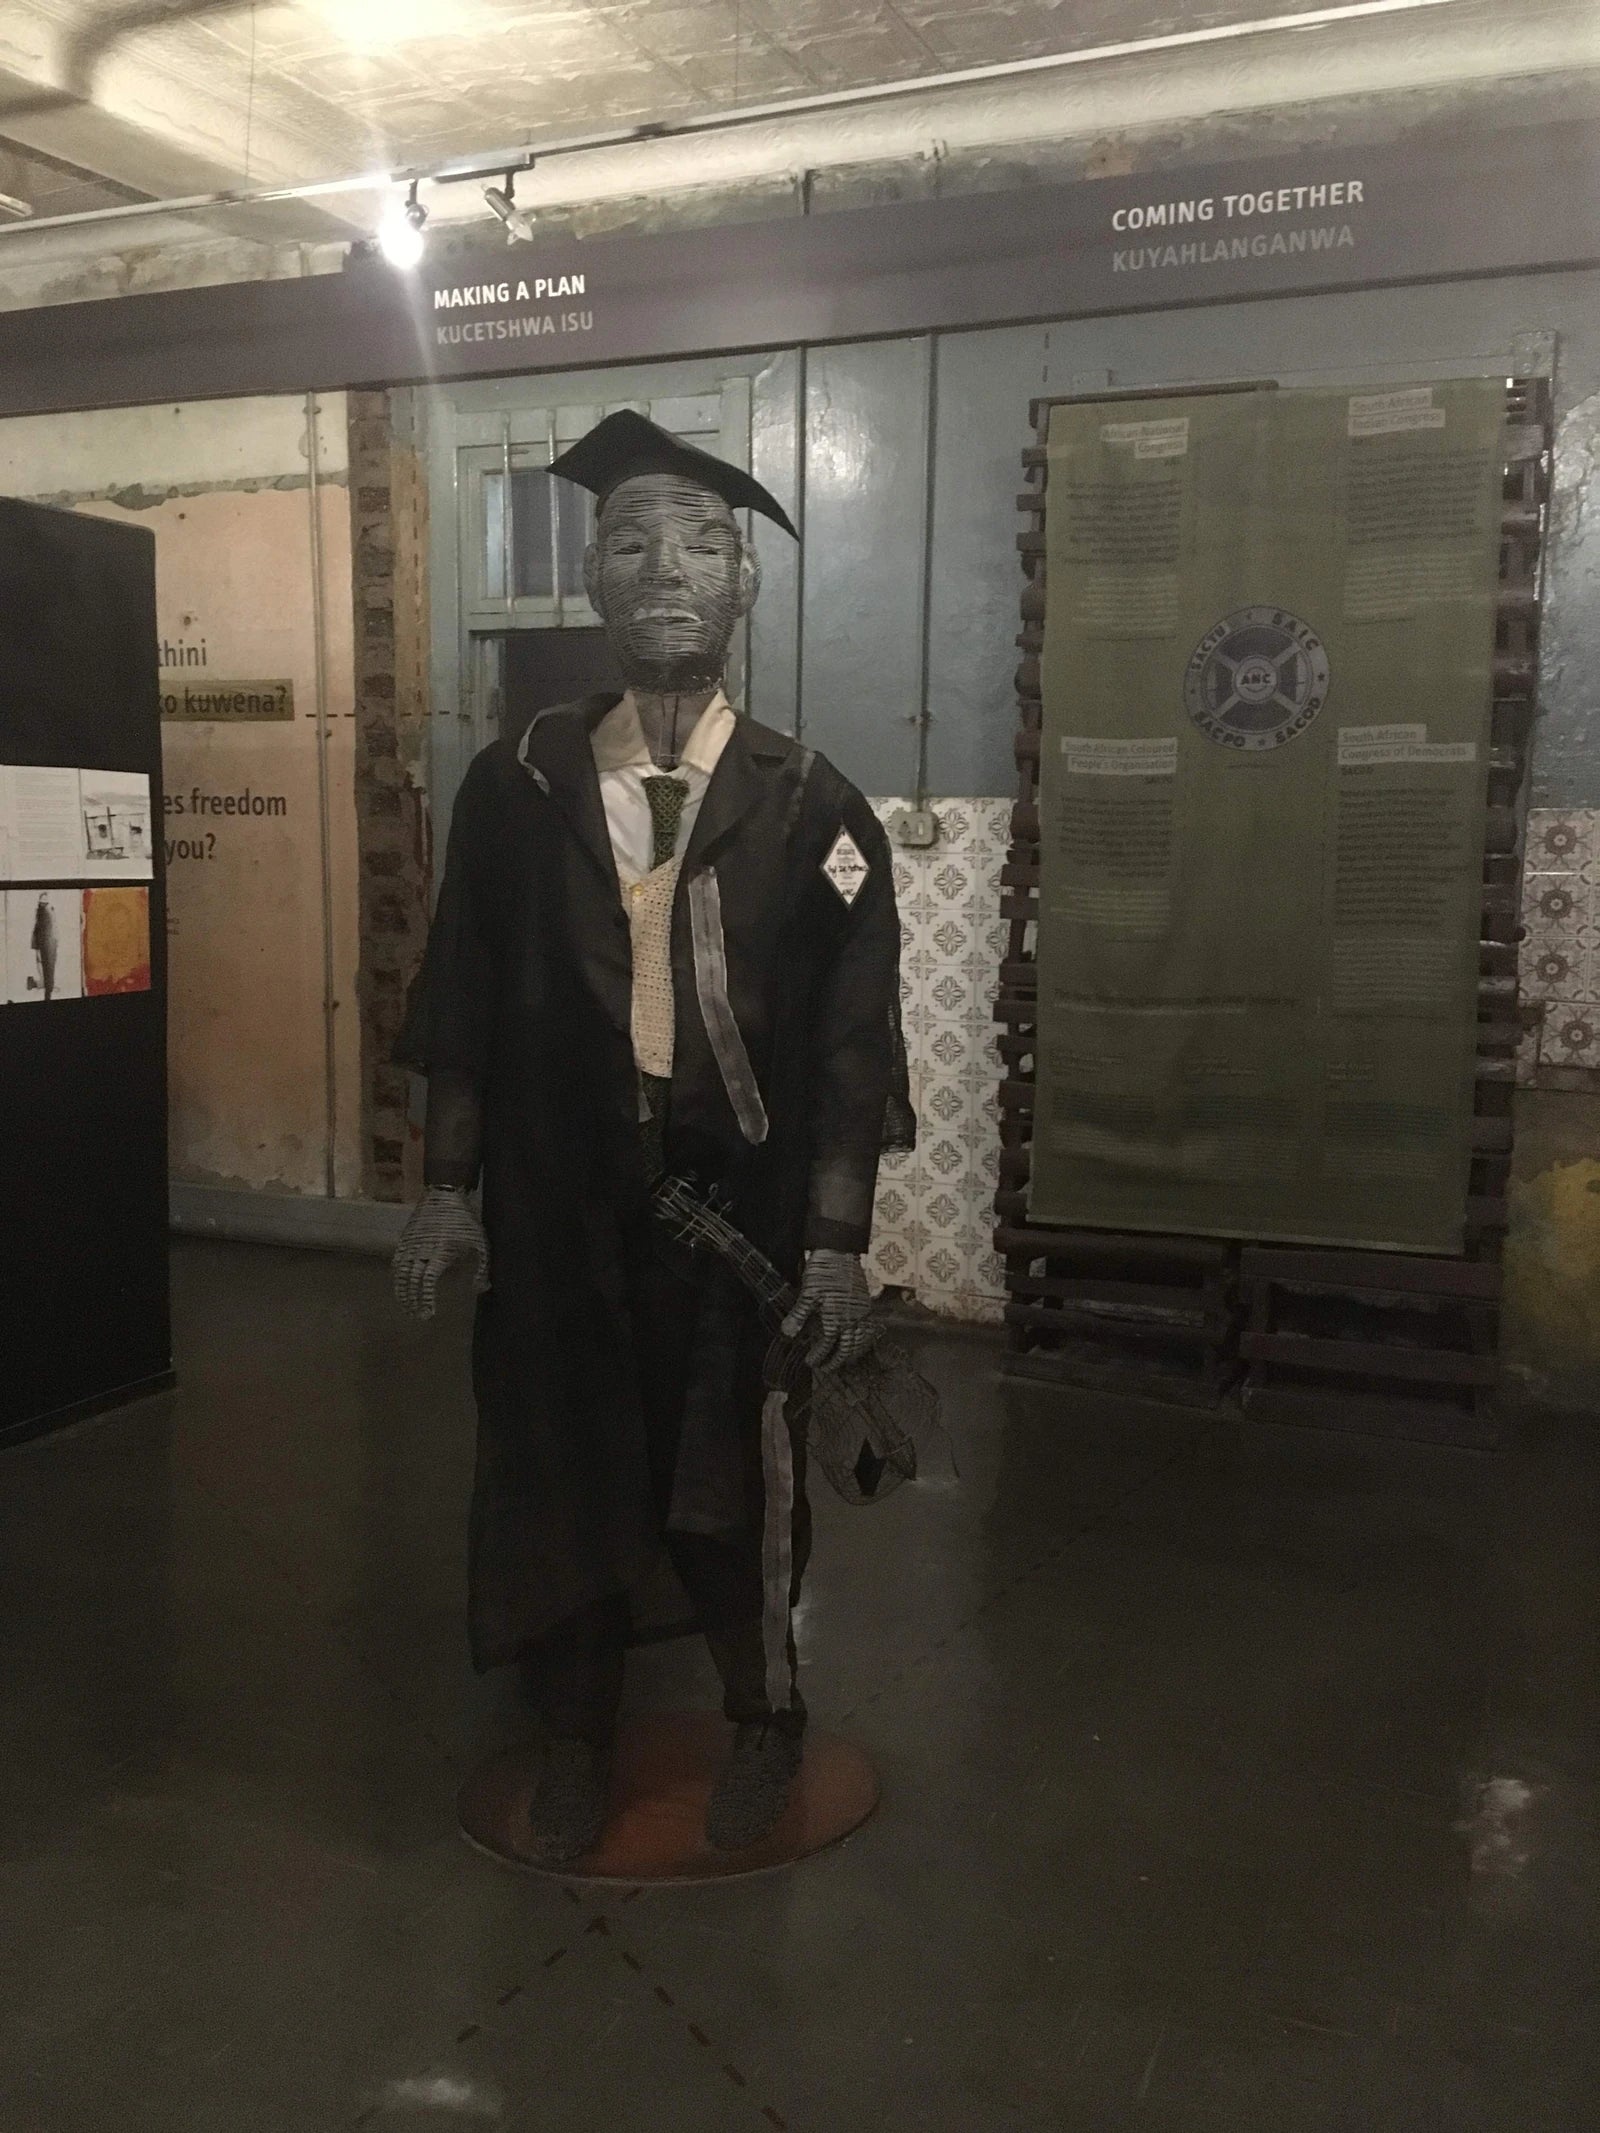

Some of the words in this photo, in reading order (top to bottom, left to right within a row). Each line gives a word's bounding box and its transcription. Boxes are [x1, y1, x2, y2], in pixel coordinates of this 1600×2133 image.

[1112, 198, 1214, 231] COMING
[1223, 180, 1364, 217] TOGETHER
[1112, 224, 1355, 273] KUYAHLANGANWA
[434, 282, 510, 310] MAKING
[515, 280, 530, 301] A
[535, 274, 586, 299] PLAN
[436, 315, 556, 345] KUCETSHWA
[561, 310, 594, 333] ISU
[1240, 673, 1271, 685] ANC
[184, 685, 288, 714] kuwena?
[1192, 710, 1247, 748] SACPO
[1274, 697, 1321, 745] SACOD
[191, 787, 287, 816] freedom
[164, 832, 217, 865] you?
